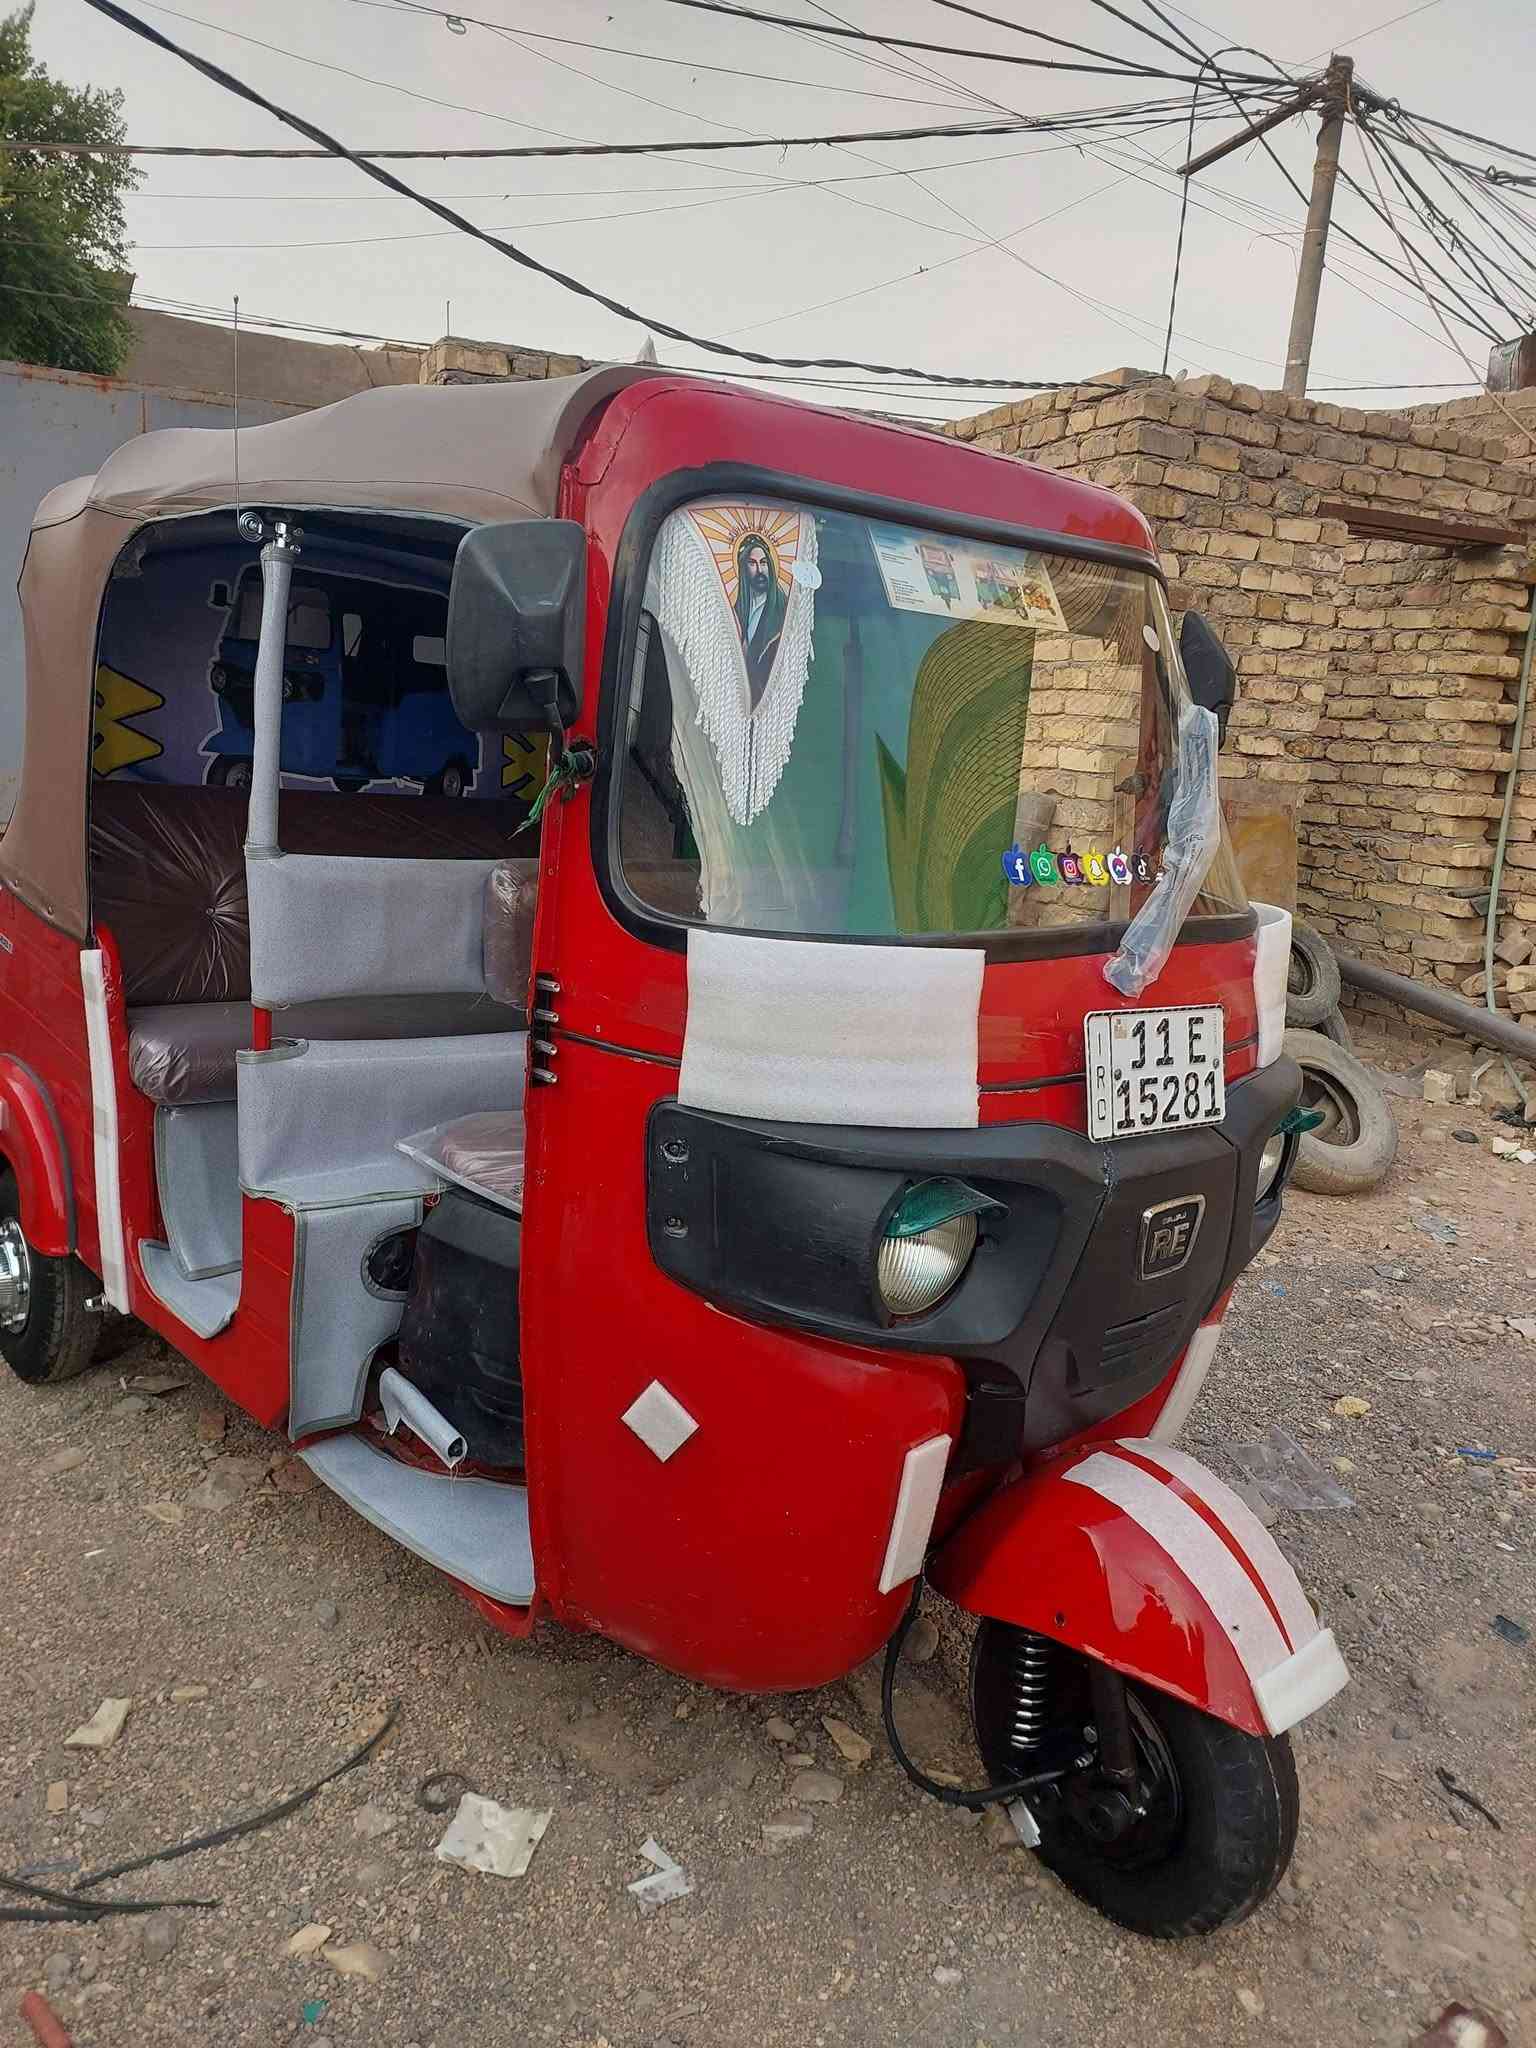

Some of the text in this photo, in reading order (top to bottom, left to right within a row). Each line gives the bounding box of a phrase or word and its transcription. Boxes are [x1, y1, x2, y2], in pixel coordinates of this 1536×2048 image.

[1131, 1016, 1206, 1069] 11 E
[1116, 1070, 1221, 1130] 15281
[1150, 1222, 1190, 1263] RE
